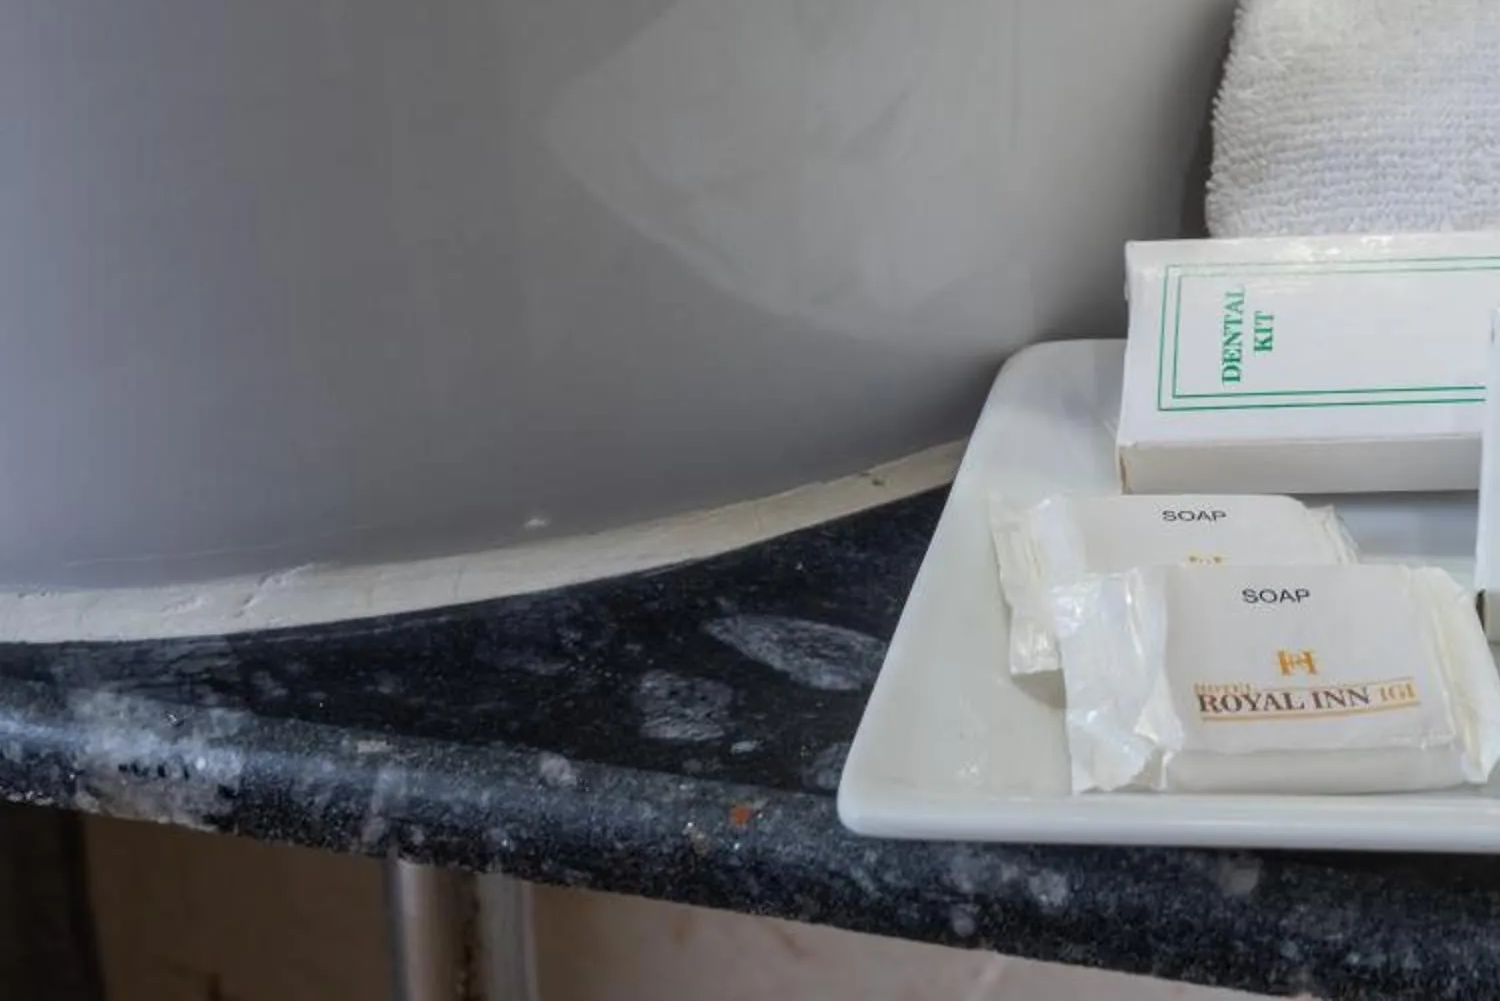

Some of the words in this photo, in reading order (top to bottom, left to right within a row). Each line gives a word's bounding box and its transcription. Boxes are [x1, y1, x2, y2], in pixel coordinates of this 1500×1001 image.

[1221, 285, 1246, 385] DENTAL
[1253, 310, 1275, 353] KIT
[1162, 510, 1227, 521] SOAP
[1242, 588, 1310, 604] SOAP
[1198, 689, 1304, 713] ROYAL
[1311, 688, 1370, 709] INN
